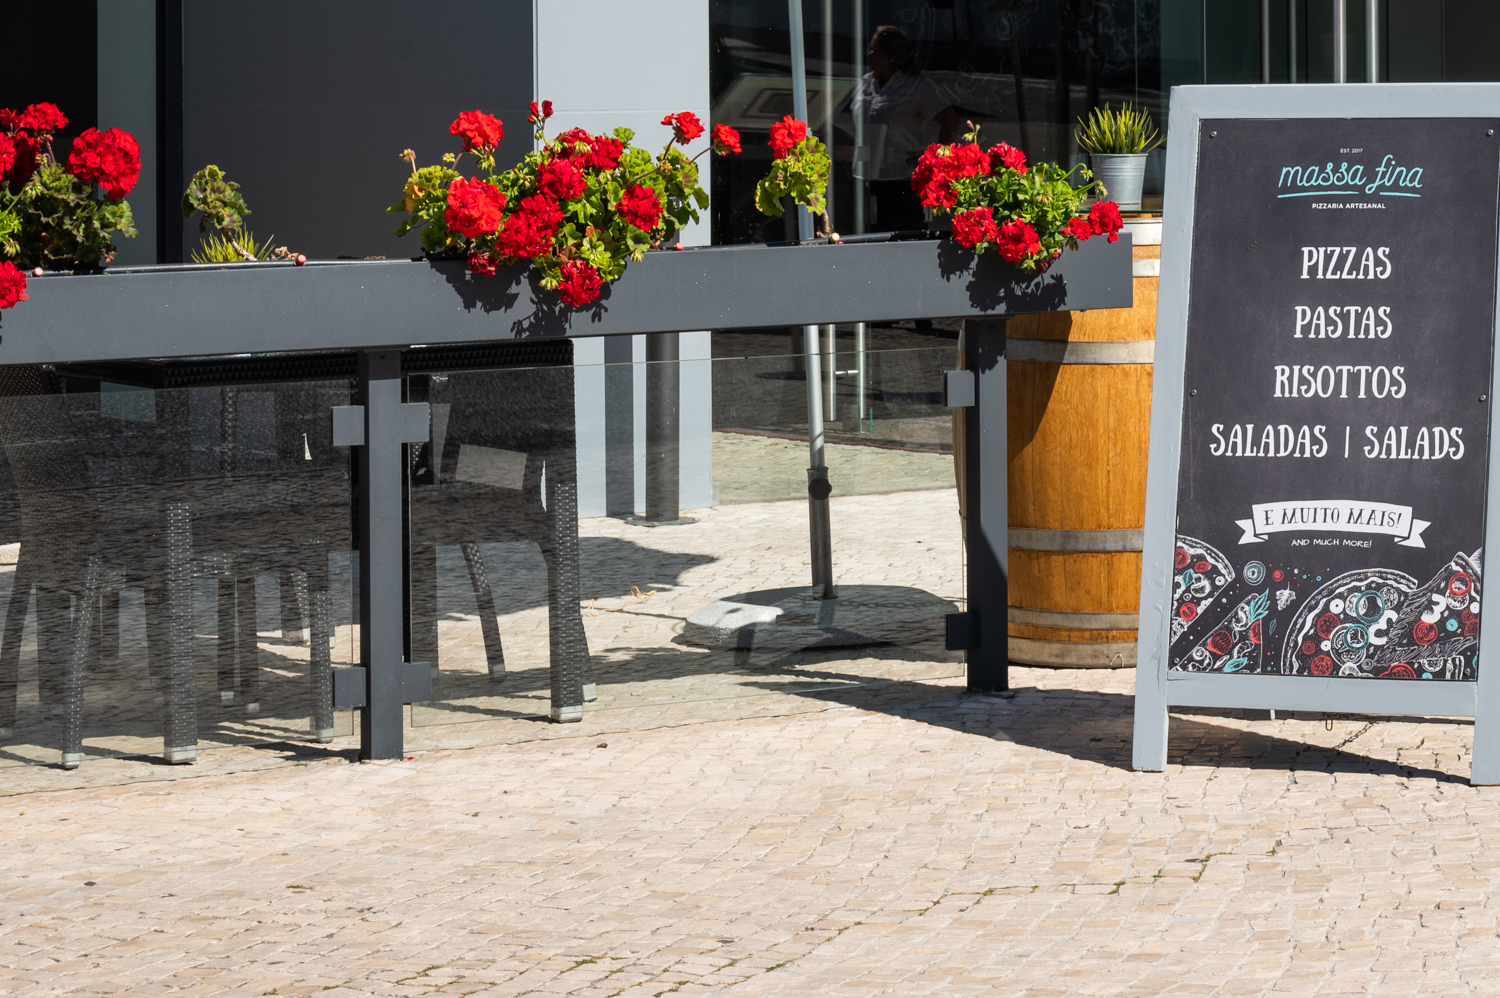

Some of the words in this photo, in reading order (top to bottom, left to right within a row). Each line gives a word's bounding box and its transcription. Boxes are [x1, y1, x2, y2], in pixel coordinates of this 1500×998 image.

[1278, 161, 1368, 188] massa
[1365, 154, 1424, 194] fina
[1300, 246, 1392, 280] PIZZAS
[1293, 305, 1393, 339] PASTAS
[1273, 364, 1407, 399] RISOTTOS
[1208, 423, 1328, 458] SALADAS
[1363, 425, 1466, 461] SALADS
[1263, 509, 1274, 526] E
[1280, 507, 1340, 525] MUITO
[1346, 507, 1402, 529] MAIS!
[1291, 538, 1310, 547] AND
[1313, 538, 1340, 546] MUCH
[1342, 539, 1372, 548] MORE!
